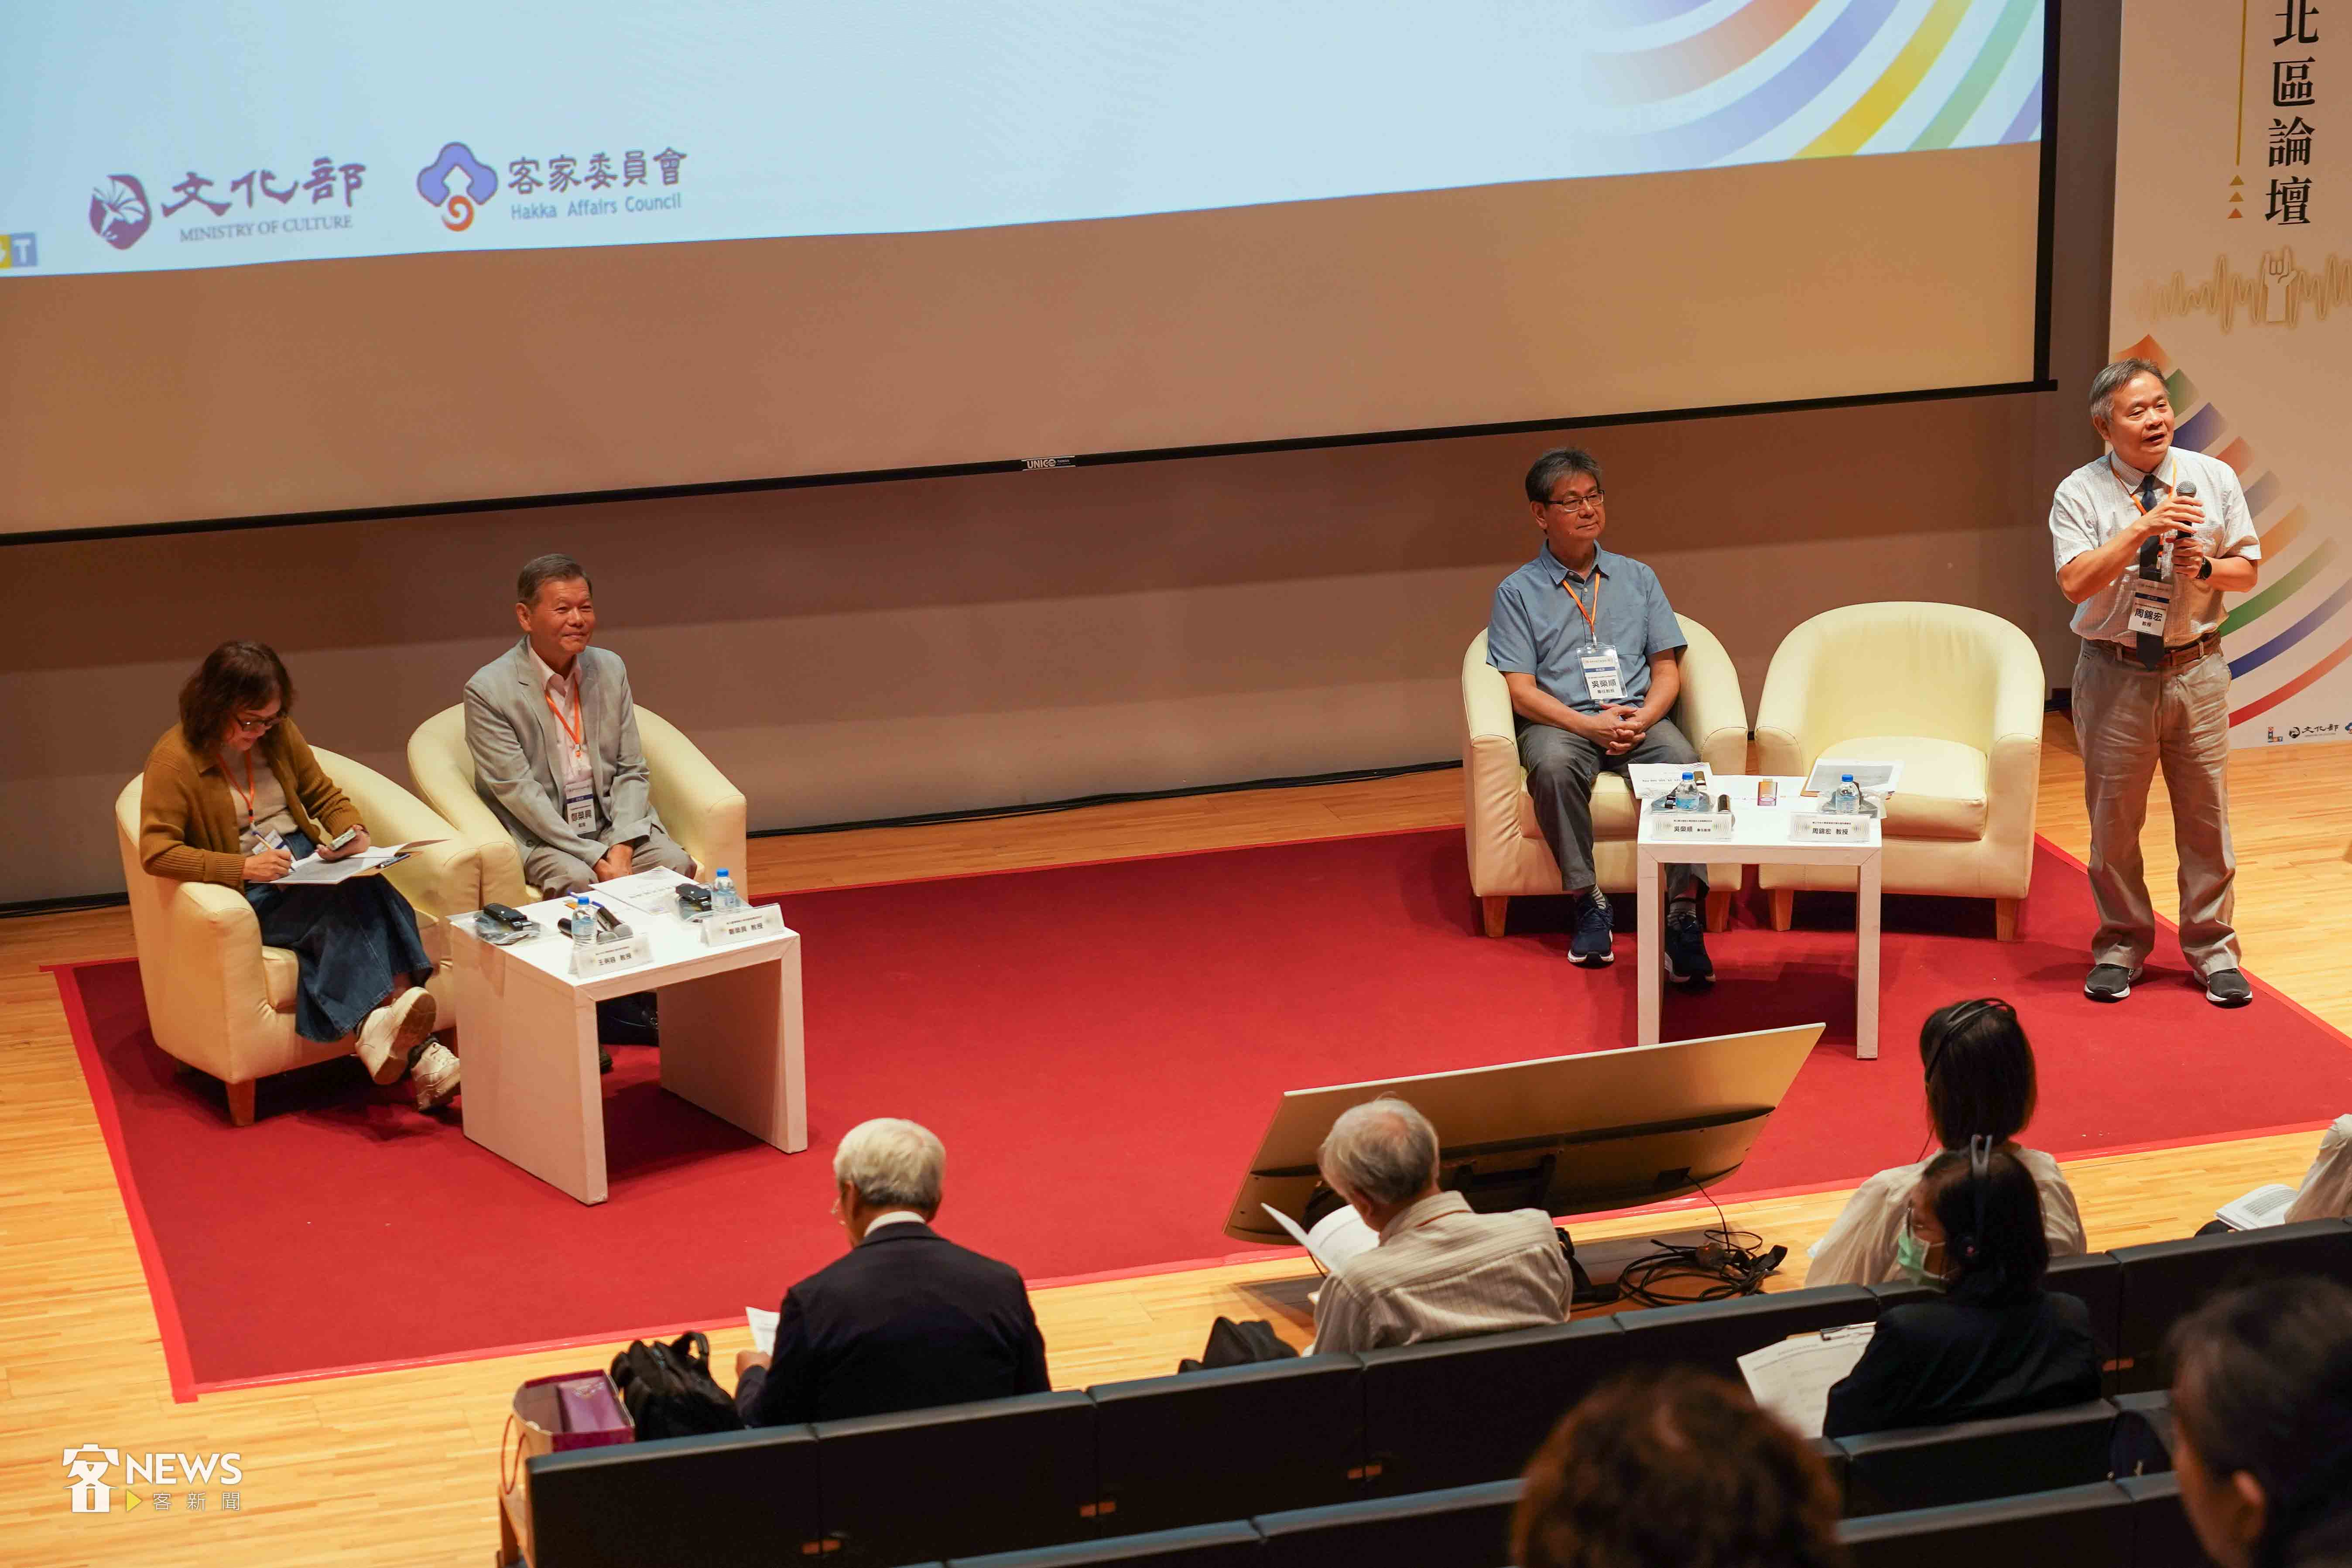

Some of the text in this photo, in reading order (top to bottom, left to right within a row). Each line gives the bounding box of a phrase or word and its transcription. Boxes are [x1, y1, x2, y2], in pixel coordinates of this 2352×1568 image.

[2265, 0, 2320, 226] 北區論壇
[508, 147, 688, 195] 客家委員會
[161, 157, 366, 217] 文化部
[511, 193, 681, 219] Hakka Affairs Council
[180, 215, 353, 243] MINISTRY OF CULTURE
[2134, 608, 2163, 621] 周錦宏
[1592, 679, 1616, 688] 吳榮順
[2302, 724, 2339, 733] 文化部
